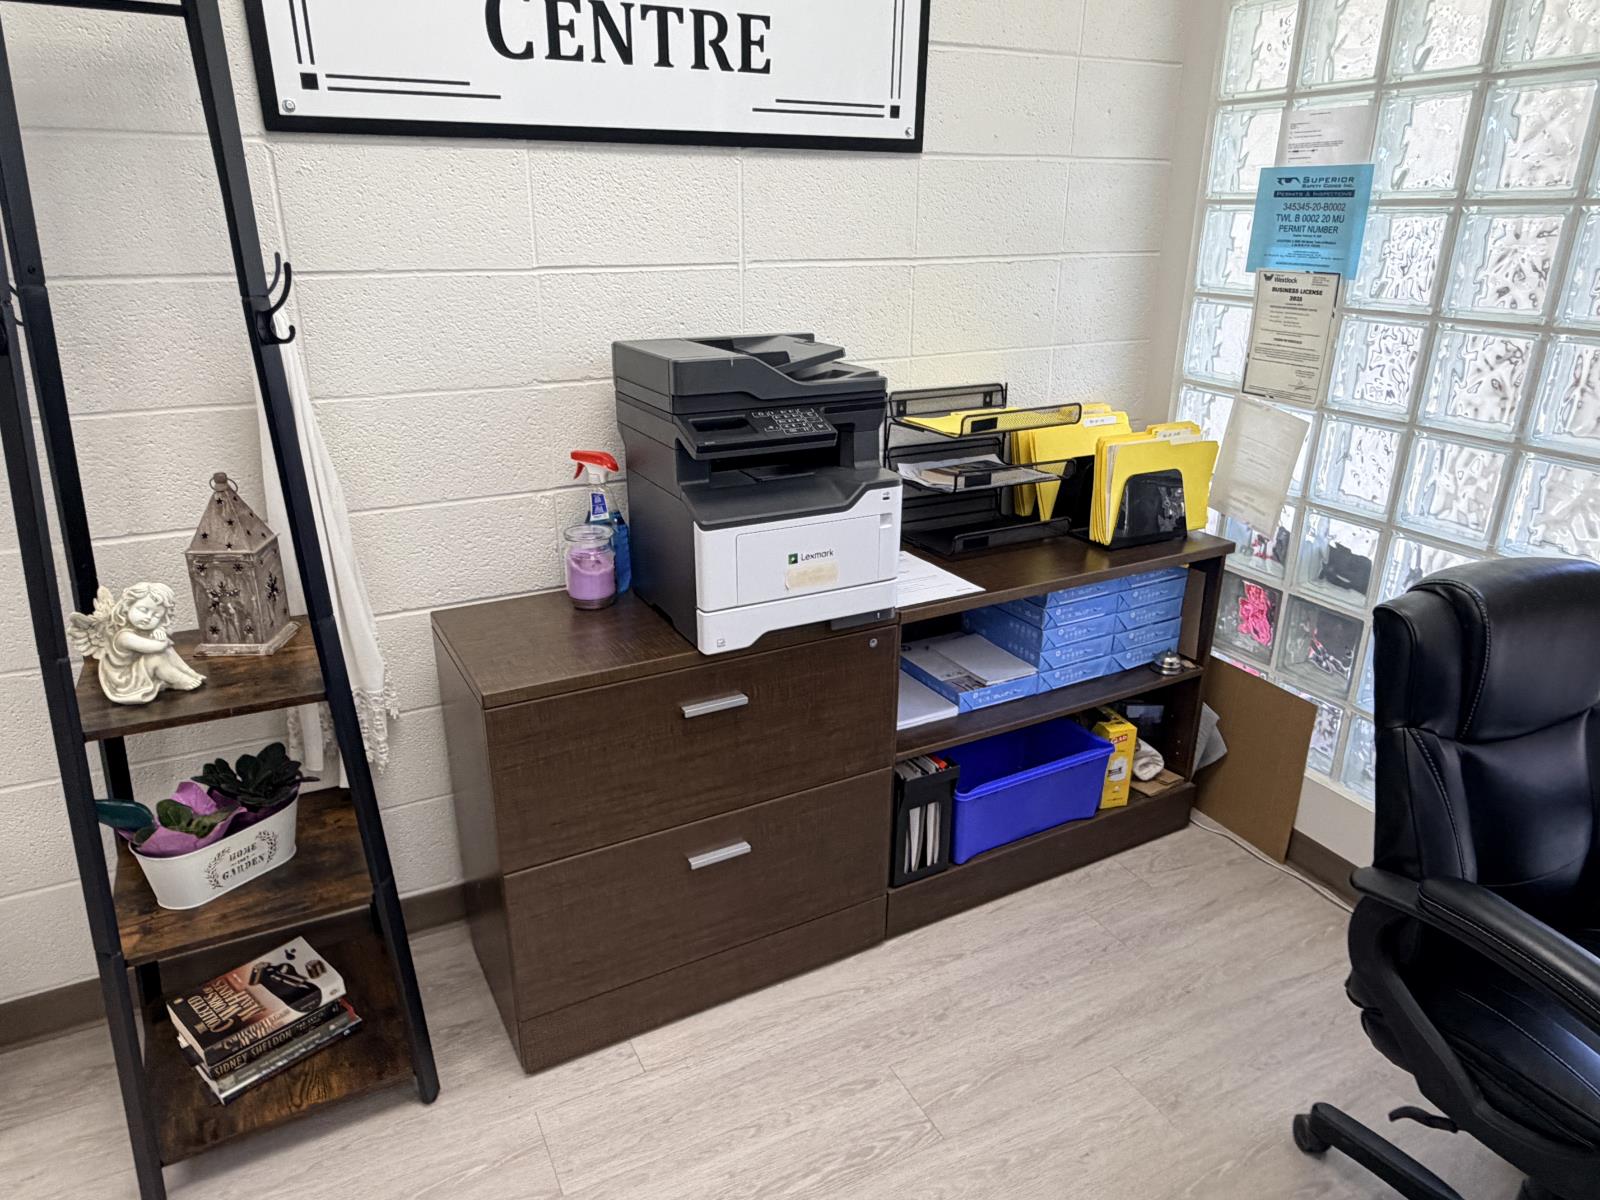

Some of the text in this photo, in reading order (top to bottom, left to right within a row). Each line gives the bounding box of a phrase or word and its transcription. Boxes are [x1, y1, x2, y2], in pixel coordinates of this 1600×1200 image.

[484, 0, 771, 74] CENTRE
[1302, 176, 1355, 184] SUPERIOR
[1276, 214, 1294, 222] TWL
[1294, 214, 1301, 222] B
[1301, 214, 1320, 223] 0002
[1321, 215, 1332, 223] 20
[1278, 225, 1339, 234] PERMIT NUMBER
[1299, 288, 1323, 296] LICENSE
[801, 549, 834, 561] Lexmark
[222, 854, 264, 880] GARDEN
[187, 995, 235, 1033] COLLECTED
[213, 1055, 249, 1077] SIDNEY
[249, 1029, 294, 1057] SHELDON
